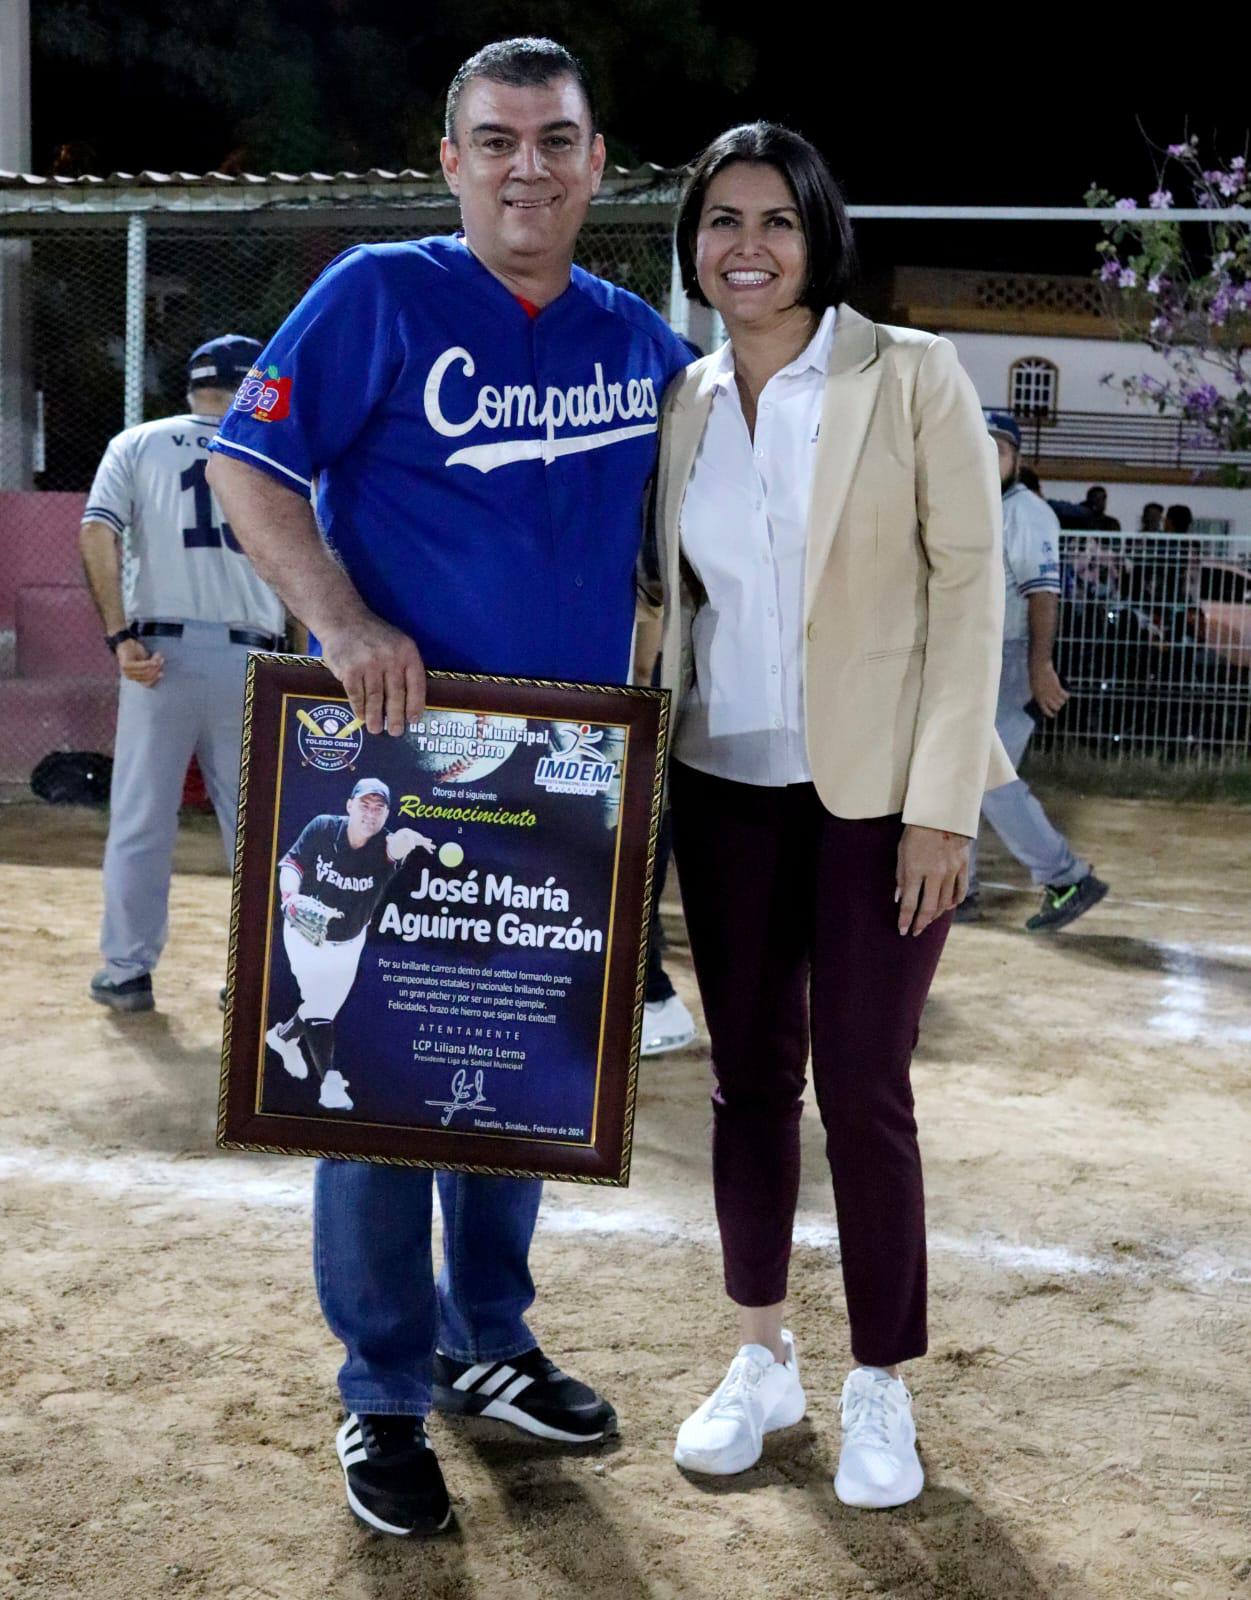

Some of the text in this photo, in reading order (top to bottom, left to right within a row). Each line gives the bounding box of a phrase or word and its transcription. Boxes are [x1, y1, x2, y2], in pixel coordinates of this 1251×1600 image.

[424, 346, 658, 441] Compadres
[180, 458, 244, 554] 1
[312, 708, 350, 722] SOFTBOL
[305, 738, 359, 748] TOLEDO CORRO
[430, 720, 478, 738] Softbol
[482, 724, 550, 746] Municipal
[417, 736, 505, 758] Toledo Corro
[537, 759, 614, 783] IMDEM
[432, 786, 498, 801] Otorga el siguiente
[398, 795, 537, 826] Reconocimiento
[457, 826, 463, 835] a
[316, 854, 374, 892] VENADOS
[411, 868, 570, 912] José María
[378, 903, 603, 953] Aguirre Garzón
[378, 958, 572, 985] Por su brillante carrera dentro del softbol formando parte
[382, 974, 392, 982] en
[393, 974, 439, 986] campeonatos
[440, 978, 470, 989] estatales
[476, 982, 513, 993] nacionales
[514, 984, 545, 995] brillando
[546, 988, 566, 998] como
[388, 1000, 428, 1013] Felicidades,
[429, 1004, 449, 1014] brazo
[450, 1006, 459, 1015] de
[460, 1006, 481, 1017] hierro
[482, 1010, 496, 1019] que
[497, 1010, 516, 1021] sigan
[516, 1012, 527, 1021] los
[399, 989, 408, 997] un
[409, 990, 425, 999] gran
[426, 990, 451, 1001] pitcher
[457, 995, 469, 1003] por
[470, 995, 482, 1003] ser
[483, 996, 492, 1004] un
[493, 997, 513, 1006] padre
[515, 999, 548, 1010] ejemplar.
[413, 1040, 526, 1060] LCP Liliana Mora Lerma
[414, 1053, 446, 1063] Presidente
[447, 1056, 460, 1066] Liga
[470, 1059, 492, 1067] Softbol
[493, 1061, 523, 1070] Municipal
[532, 1124, 558, 1134] Febrero
[558, 1127, 567, 1135] de
[568, 1127, 585, 1137] 2024
